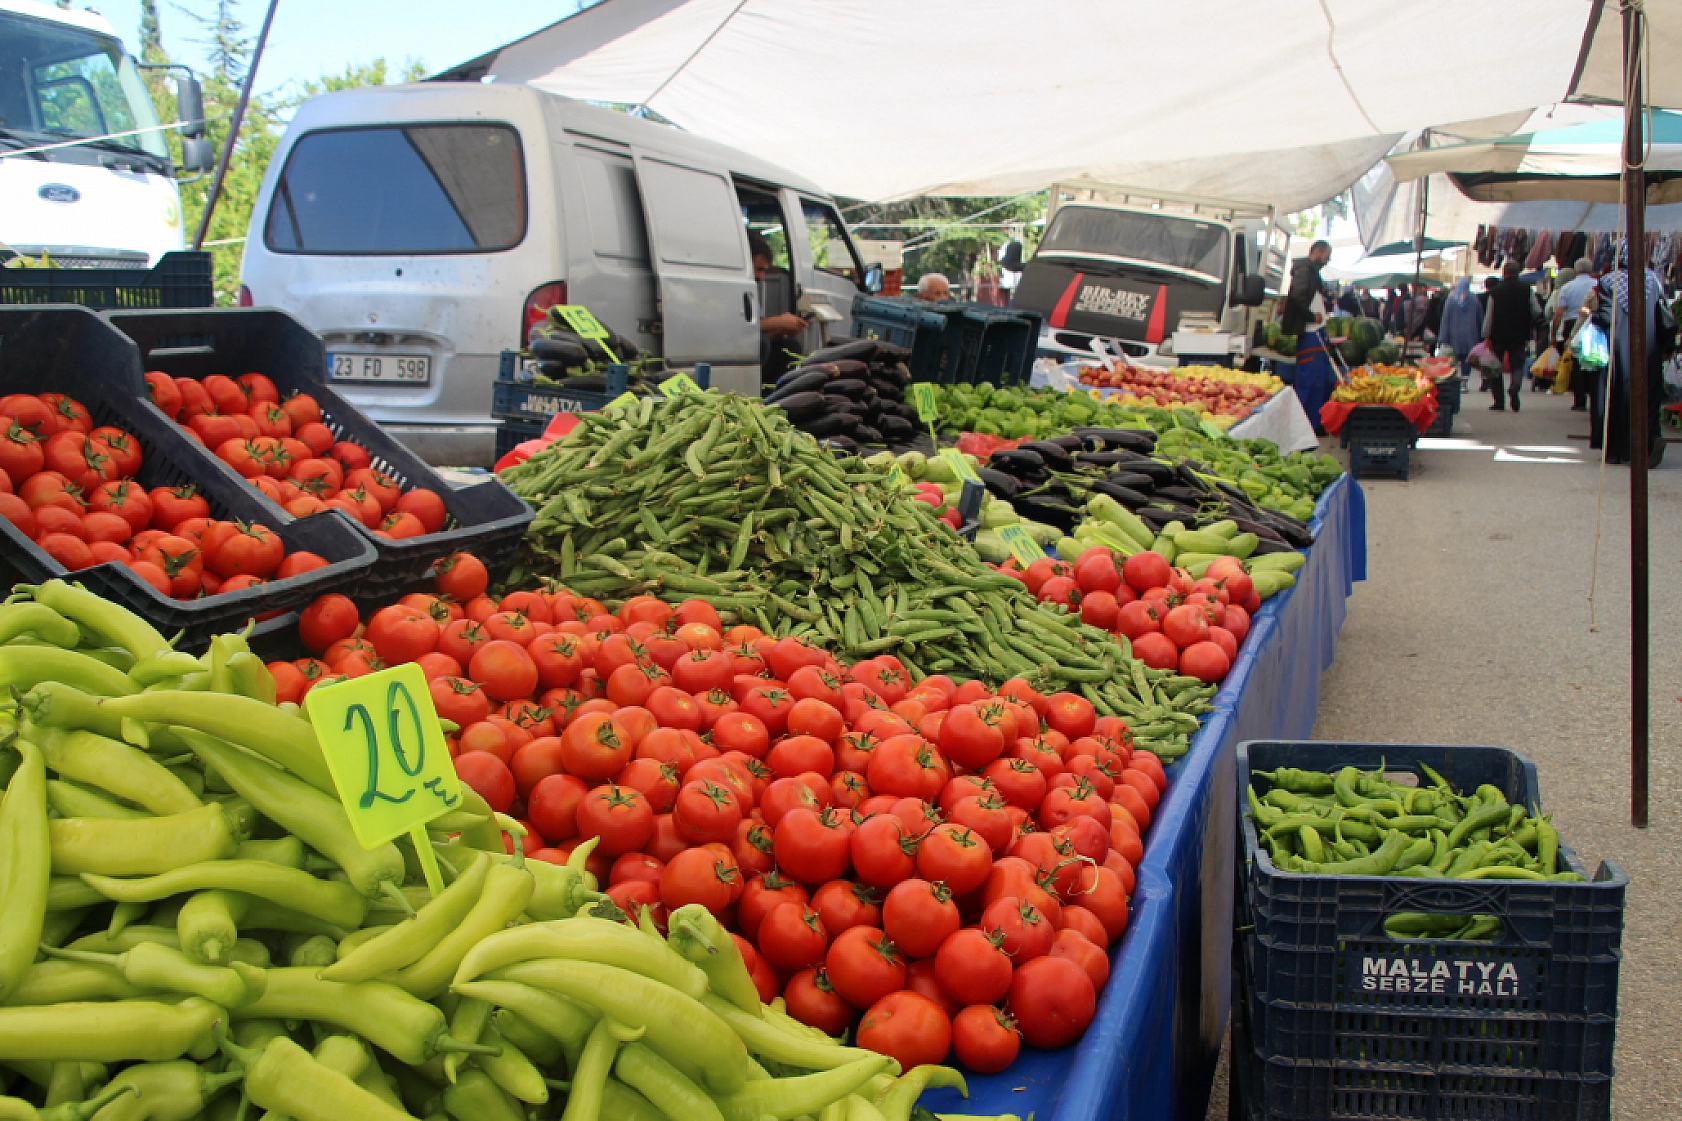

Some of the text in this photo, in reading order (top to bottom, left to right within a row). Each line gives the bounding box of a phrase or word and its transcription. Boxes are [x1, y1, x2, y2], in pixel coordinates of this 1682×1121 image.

[334, 357, 426, 378] 23 FD 598
[343, 681, 425, 809] 20
[1362, 957, 1518, 981] MALATYA
[1362, 976, 1445, 993] SEBZE
